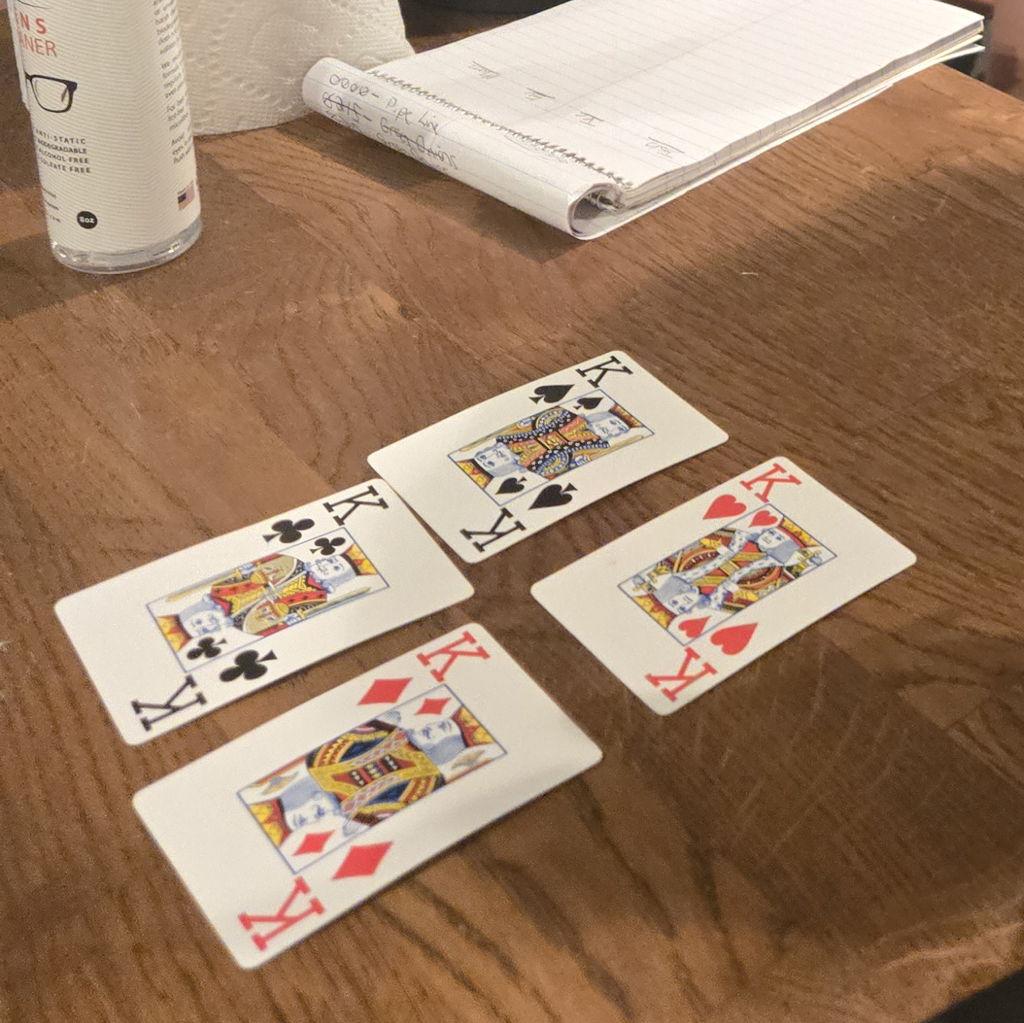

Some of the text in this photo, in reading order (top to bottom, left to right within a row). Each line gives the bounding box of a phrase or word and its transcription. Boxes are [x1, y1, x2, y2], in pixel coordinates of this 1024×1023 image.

[574, 354, 634, 388] K
[322, 484, 389, 526] K
[739, 462, 801, 503] K
[459, 507, 527, 553] K
[415, 631, 491, 683] K
[646, 646, 718, 702] K
[131, 675, 208, 731] K
[238, 876, 326, 952] K
